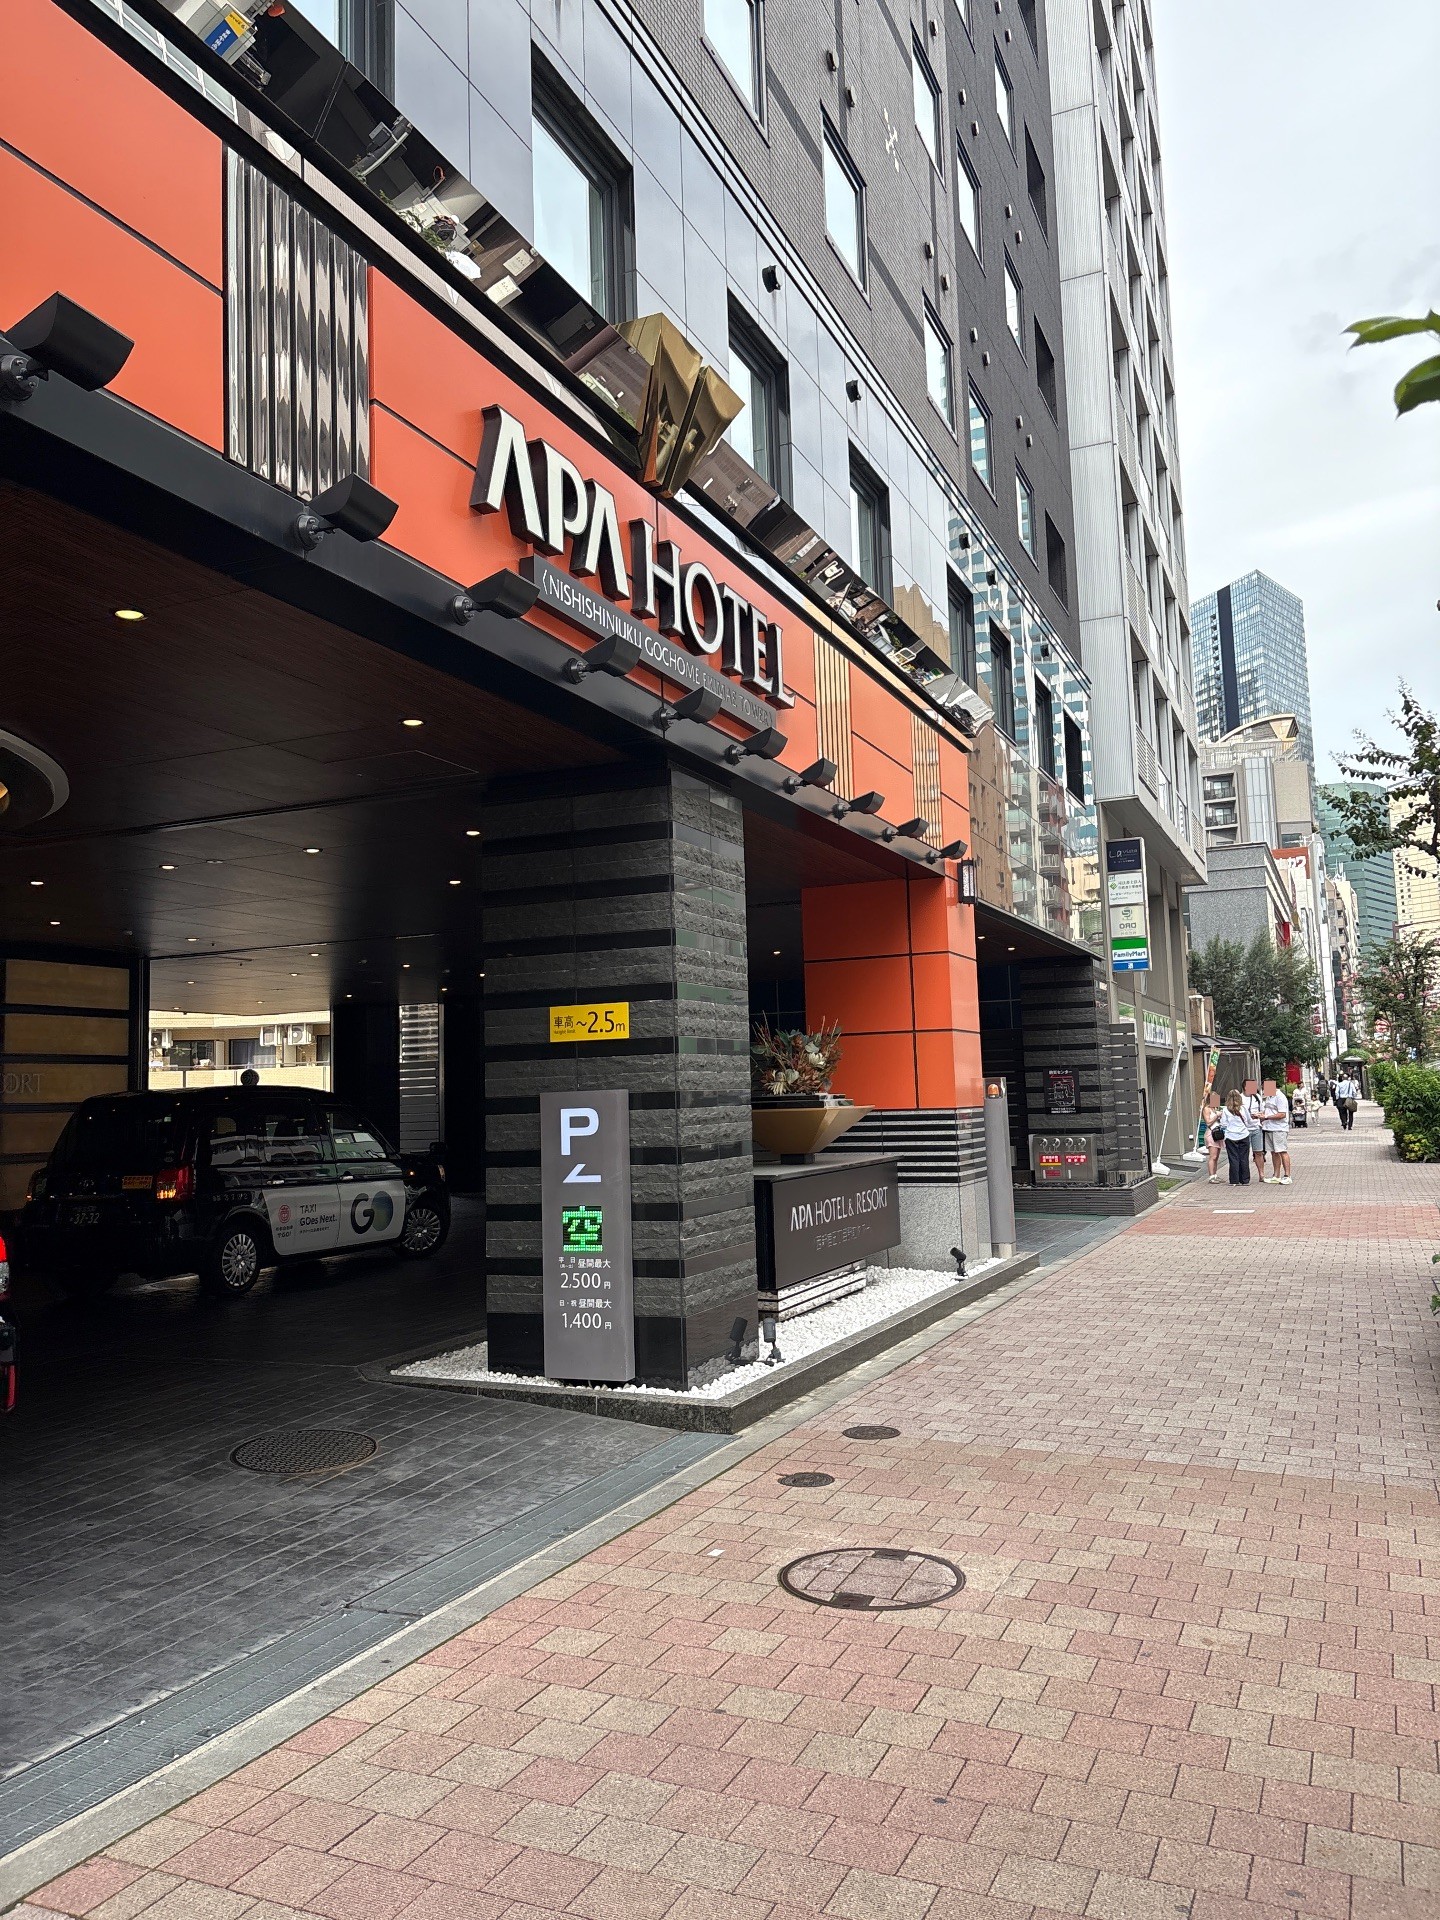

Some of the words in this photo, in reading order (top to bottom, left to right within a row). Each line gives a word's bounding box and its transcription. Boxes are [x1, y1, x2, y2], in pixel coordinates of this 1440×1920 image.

[471, 404, 630, 601] APA
[629, 518, 796, 709] HOTEL
[644, 638, 701, 685] GOCHOME
[1113, 950, 1146, 959] FamilyMart
[559, 1107, 600, 1156] P
[299, 1203, 318, 1215] TAXI
[299, 1216, 319, 1227] GOes
[350, 1191, 394, 1235] GO
[562, 1206, 603, 1253] 空
[790, 1203, 814, 1232] APA
[815, 1196, 848, 1226] HOTEL
[848, 1198, 854, 1217] &
[856, 1186, 889, 1215] RESORT
